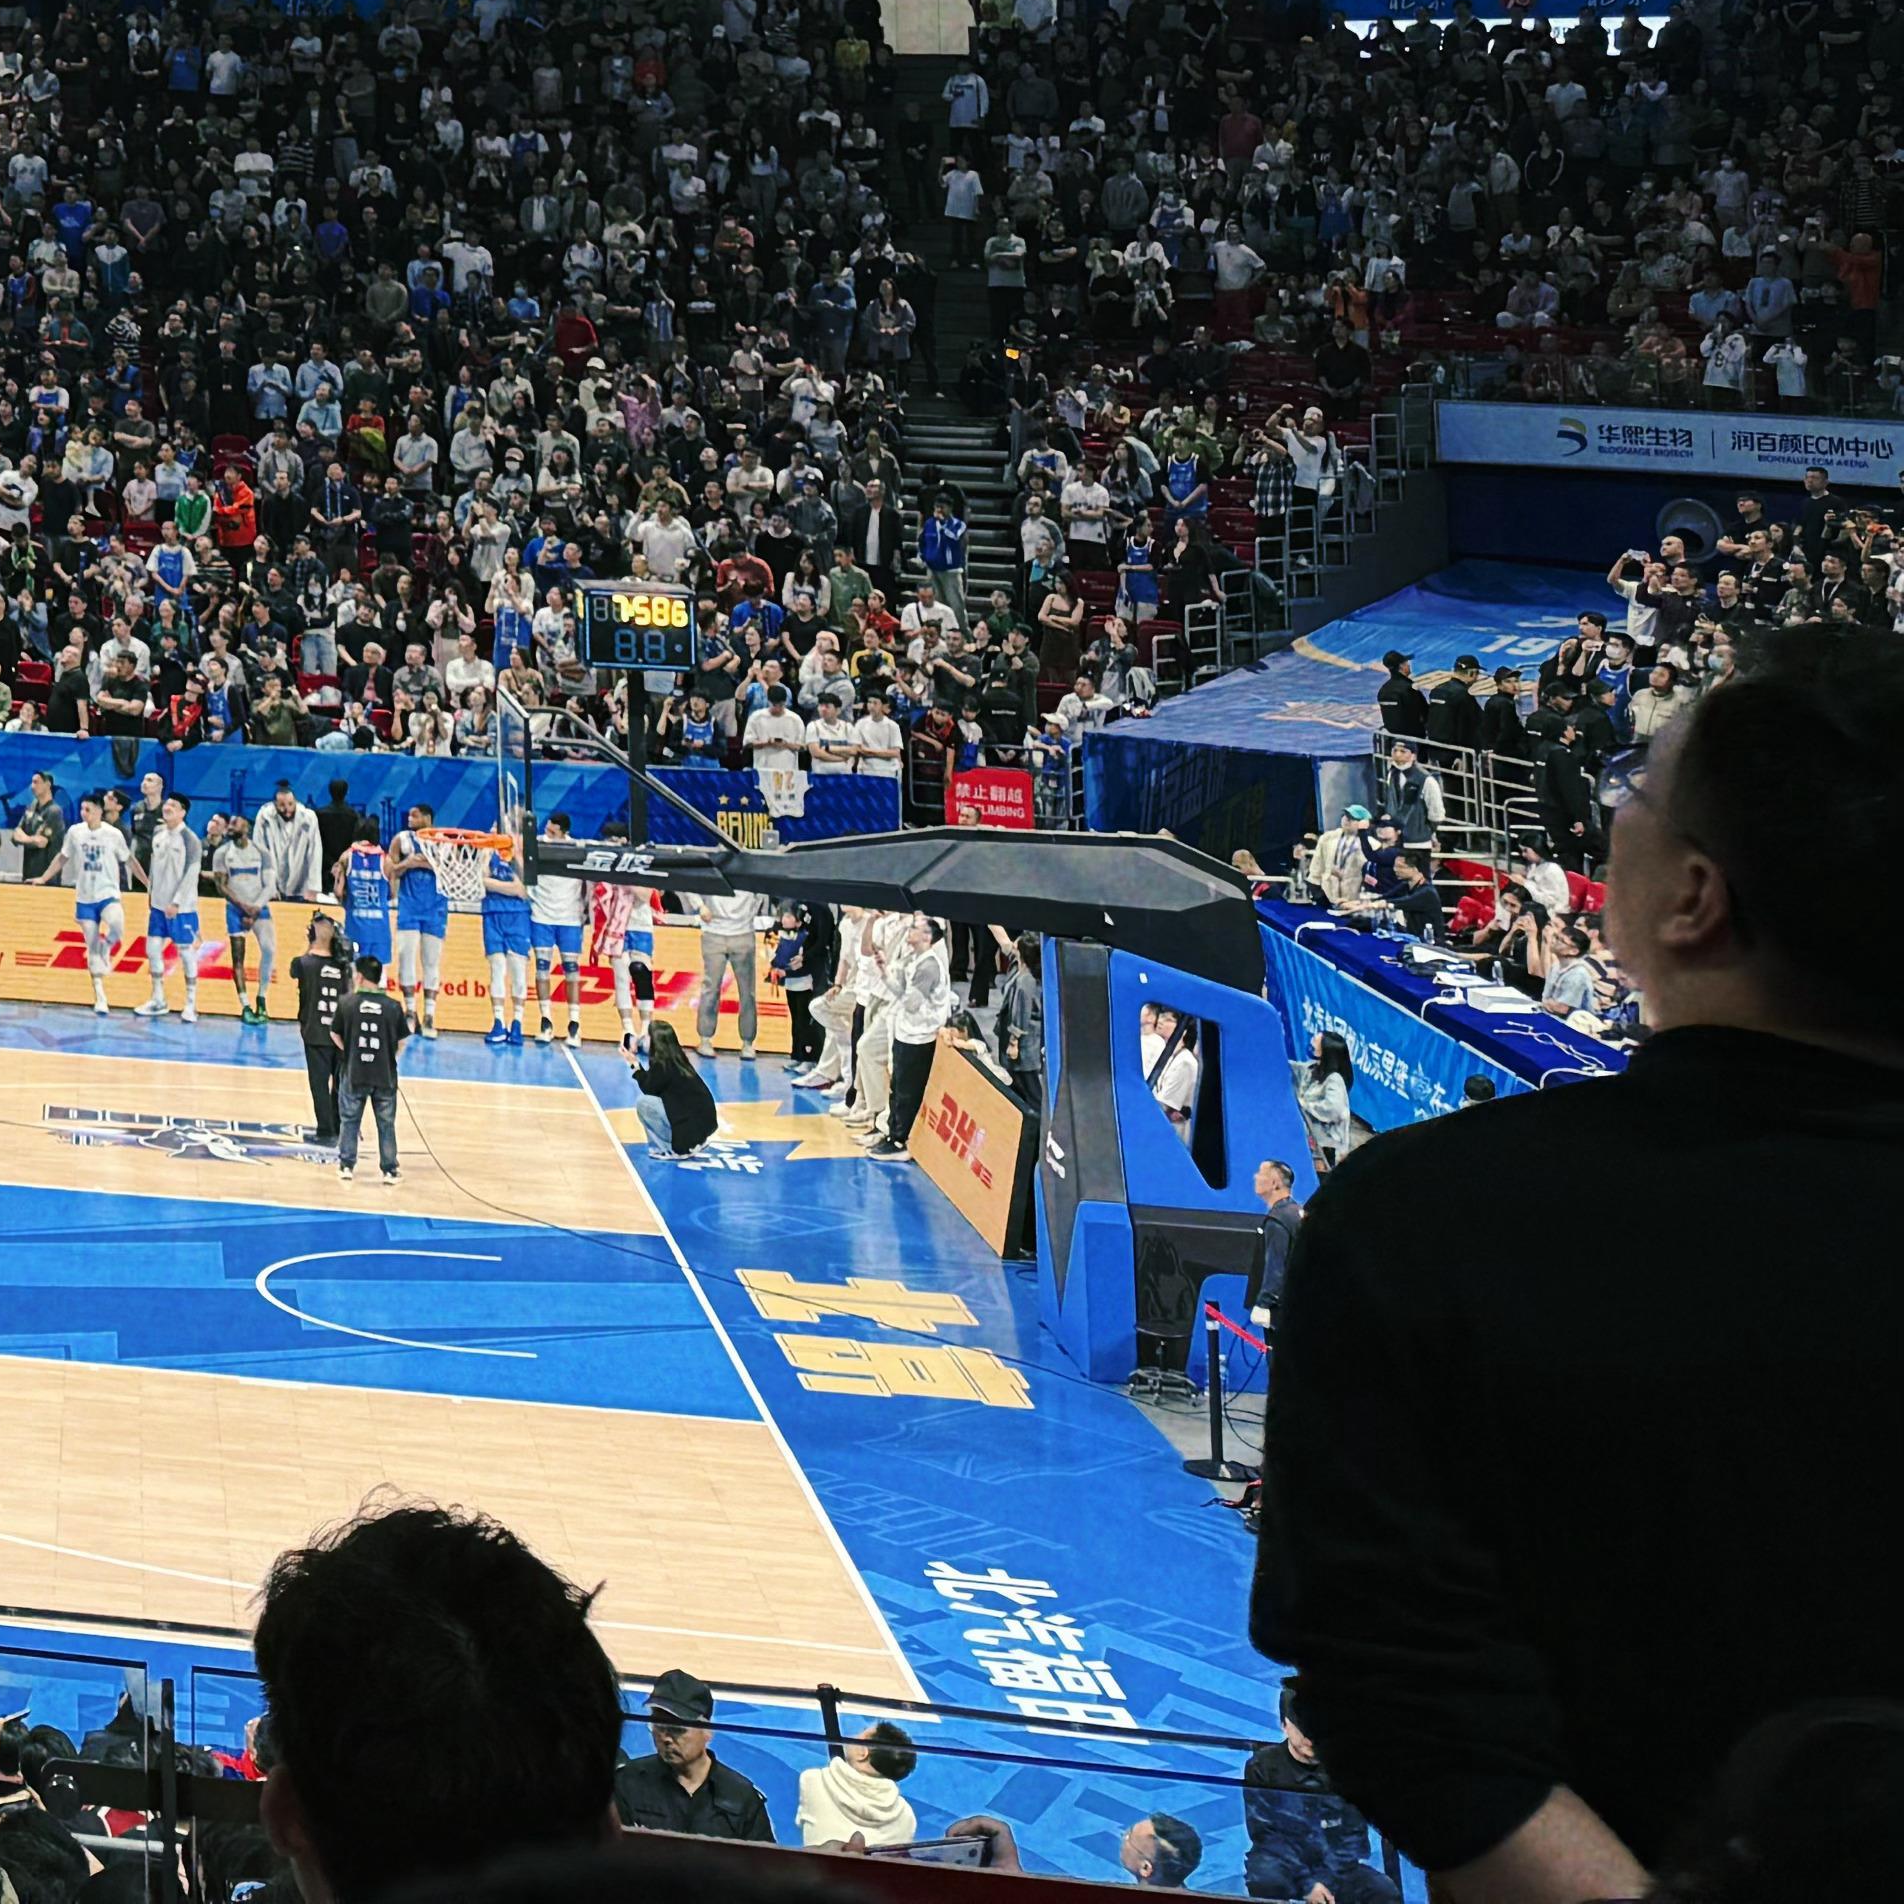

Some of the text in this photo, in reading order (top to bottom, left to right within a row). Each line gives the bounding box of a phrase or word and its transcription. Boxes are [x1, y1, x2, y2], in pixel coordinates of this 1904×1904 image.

[1597, 424, 1894, 460] 华熙生物 润百颜ECM中心
[734, 1269, 1036, 1409] 北京
[923, 1560, 1150, 1745] 北汽福田
